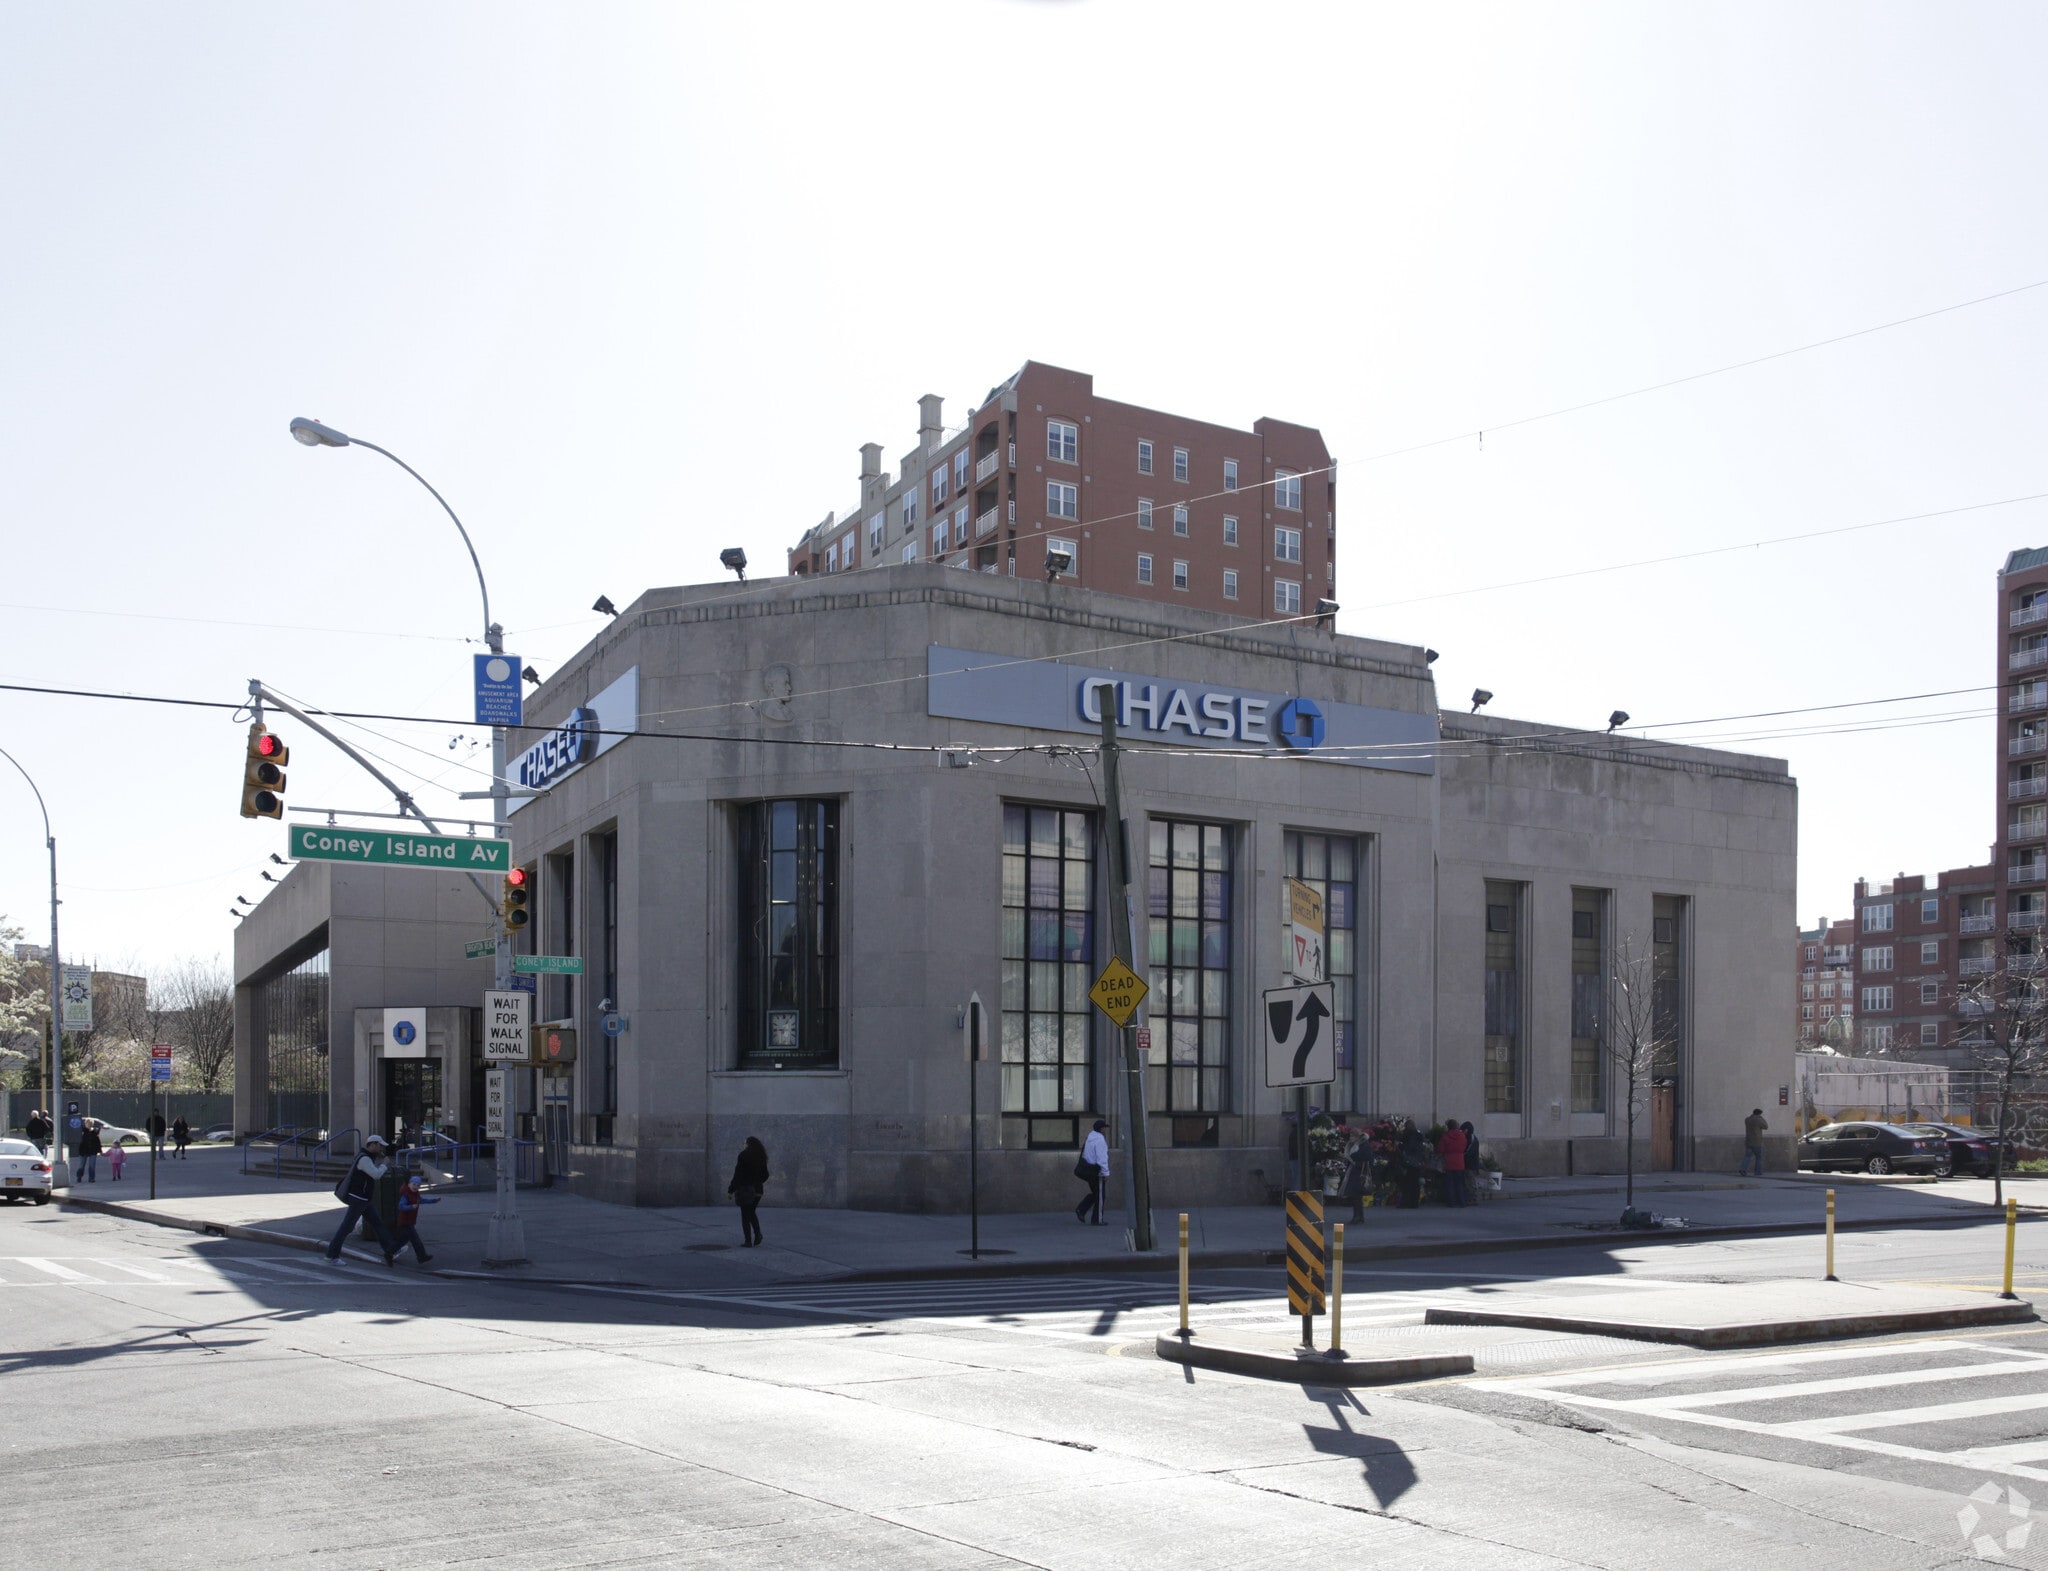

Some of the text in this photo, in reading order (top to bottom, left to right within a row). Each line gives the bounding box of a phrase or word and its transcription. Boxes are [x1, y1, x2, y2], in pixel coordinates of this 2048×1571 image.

[1080, 677, 1271, 744] CHASE
[302, 831, 499, 862] Coney Island Av
[516, 957, 579, 968] CONEY ISLAND
[1100, 976, 1134, 992] DEAD
[493, 998, 521, 1009] WAIT
[1106, 995, 1131, 1009] END
[495, 1013, 518, 1024] FOR
[491, 1027, 523, 1039] WALK
[488, 1042, 524, 1054] SIGNAL
[489, 1077, 501, 1088] WAIT
[490, 1092, 501, 1103] FOR
[488, 1106, 502, 1117] WALK
[487, 1121, 503, 1133] SIGNAL
